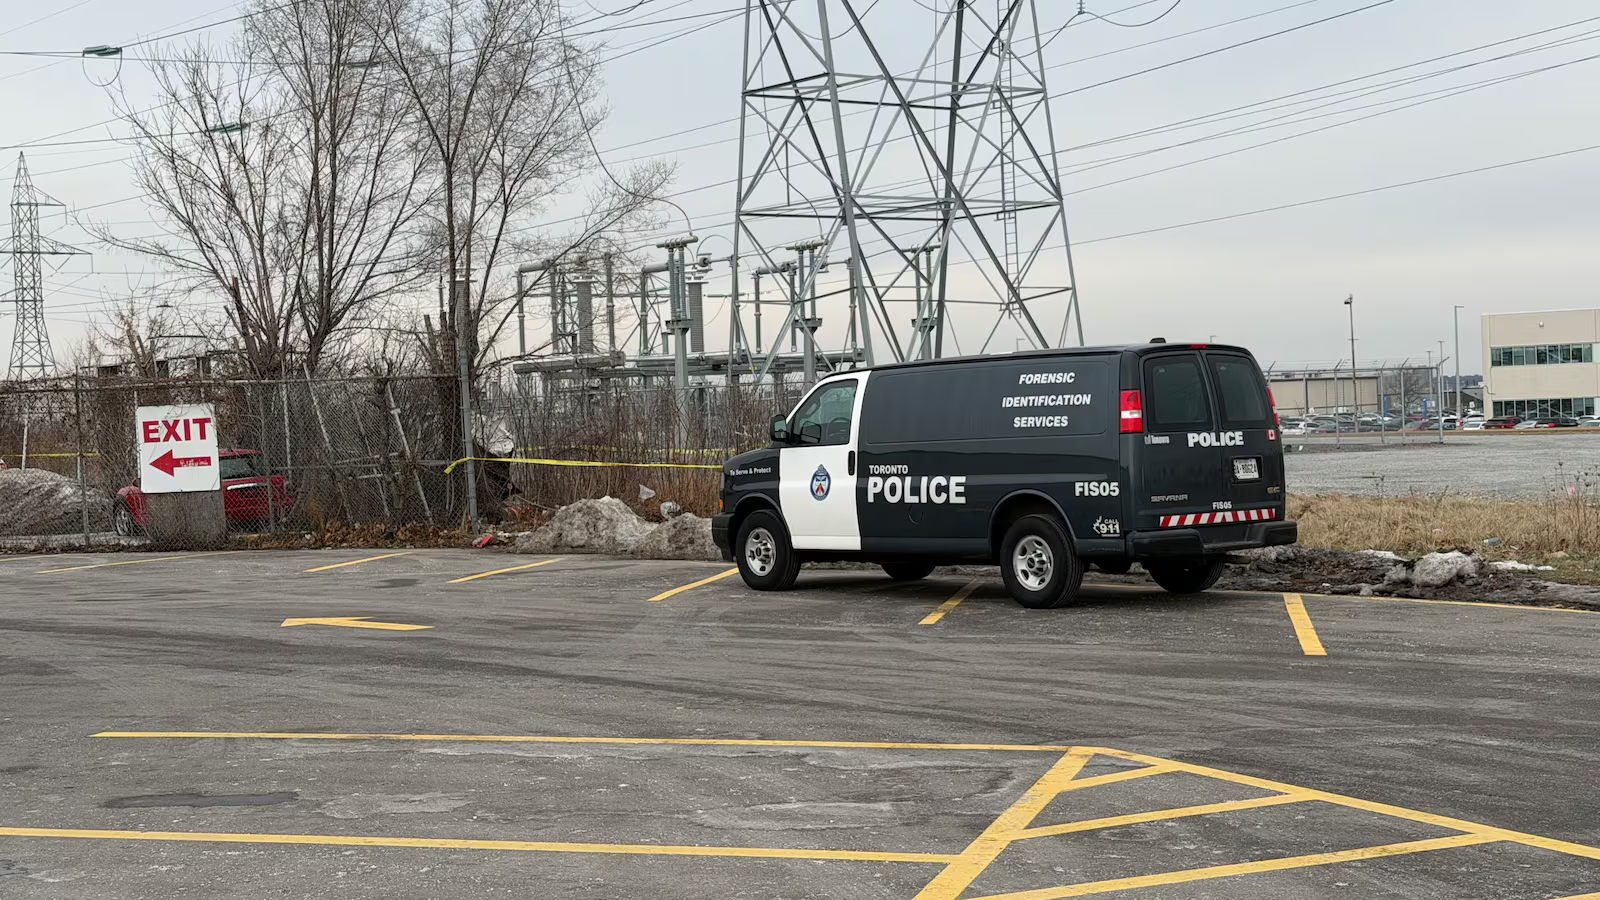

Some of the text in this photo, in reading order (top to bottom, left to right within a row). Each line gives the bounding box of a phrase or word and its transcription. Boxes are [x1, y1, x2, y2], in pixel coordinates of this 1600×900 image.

[1018, 372, 1075, 385] FORENSIC
[1001, 394, 1091, 408] IDENTIFICATION
[1013, 415, 1068, 428] SERVICES
[142, 417, 211, 443] EXIT
[1188, 432, 1244, 447] POLICE
[868, 464, 908, 475] TORONTO
[867, 476, 967, 503] POLICE
[1074, 481, 1120, 497] FIS05
[1151, 494, 1188, 502] SAVANA
[1212, 501, 1232, 510] FIS05
